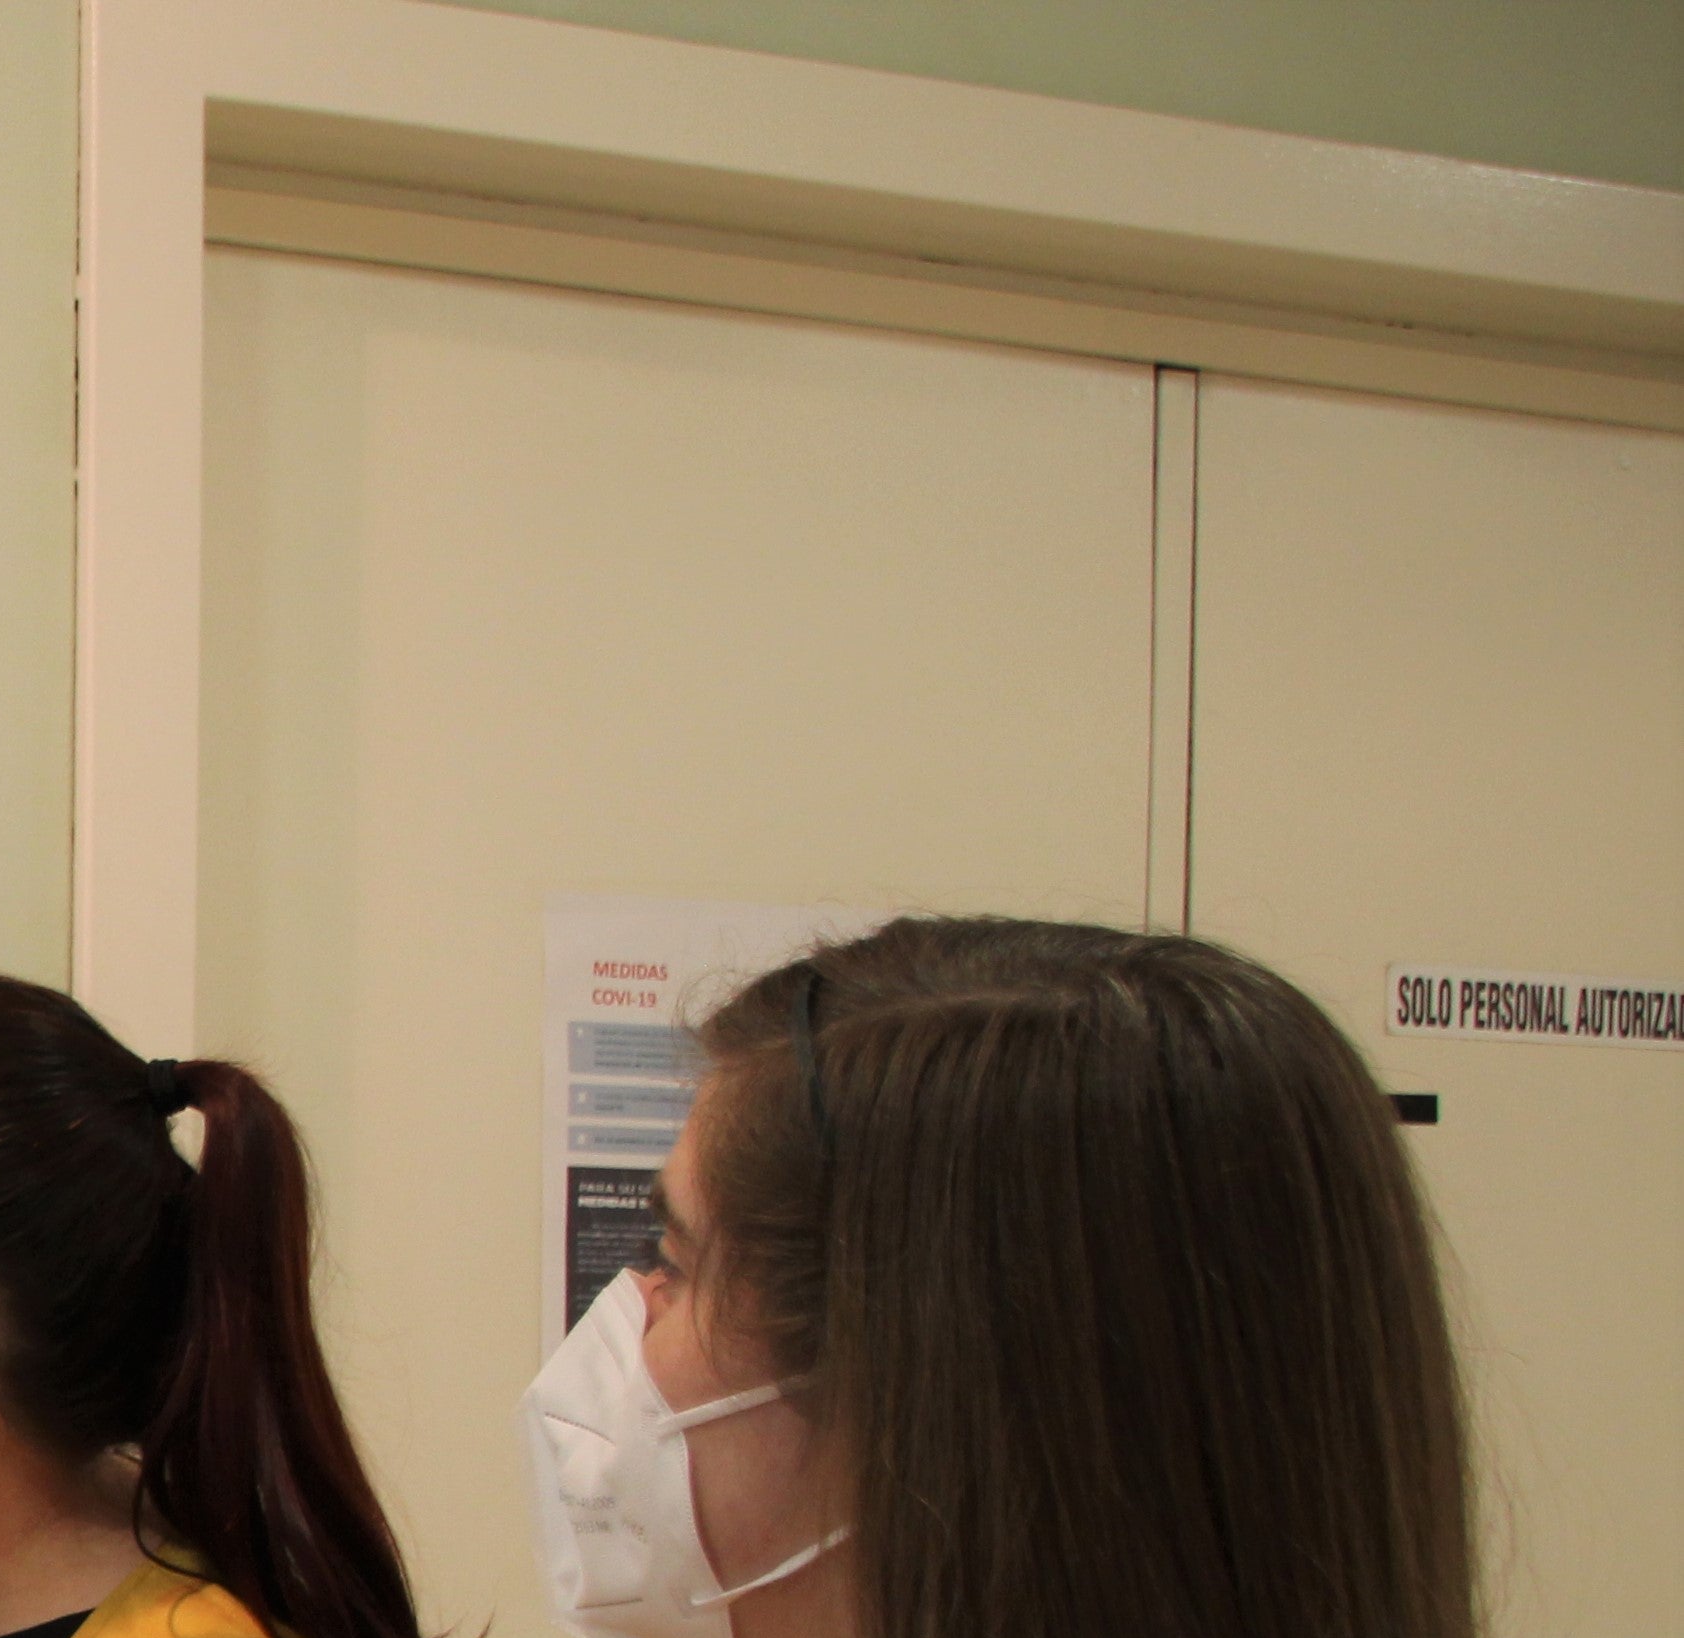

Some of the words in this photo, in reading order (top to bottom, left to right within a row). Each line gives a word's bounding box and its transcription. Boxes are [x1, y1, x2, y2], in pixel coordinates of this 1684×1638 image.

[593, 960, 668, 981] MEDIDAS
[592, 988, 658, 1008] COVI-19
[1396, 975, 1452, 1028] SOLO
[1458, 980, 1569, 1034] PERSONAL
[1575, 986, 1684, 1041] AUTORIZA
